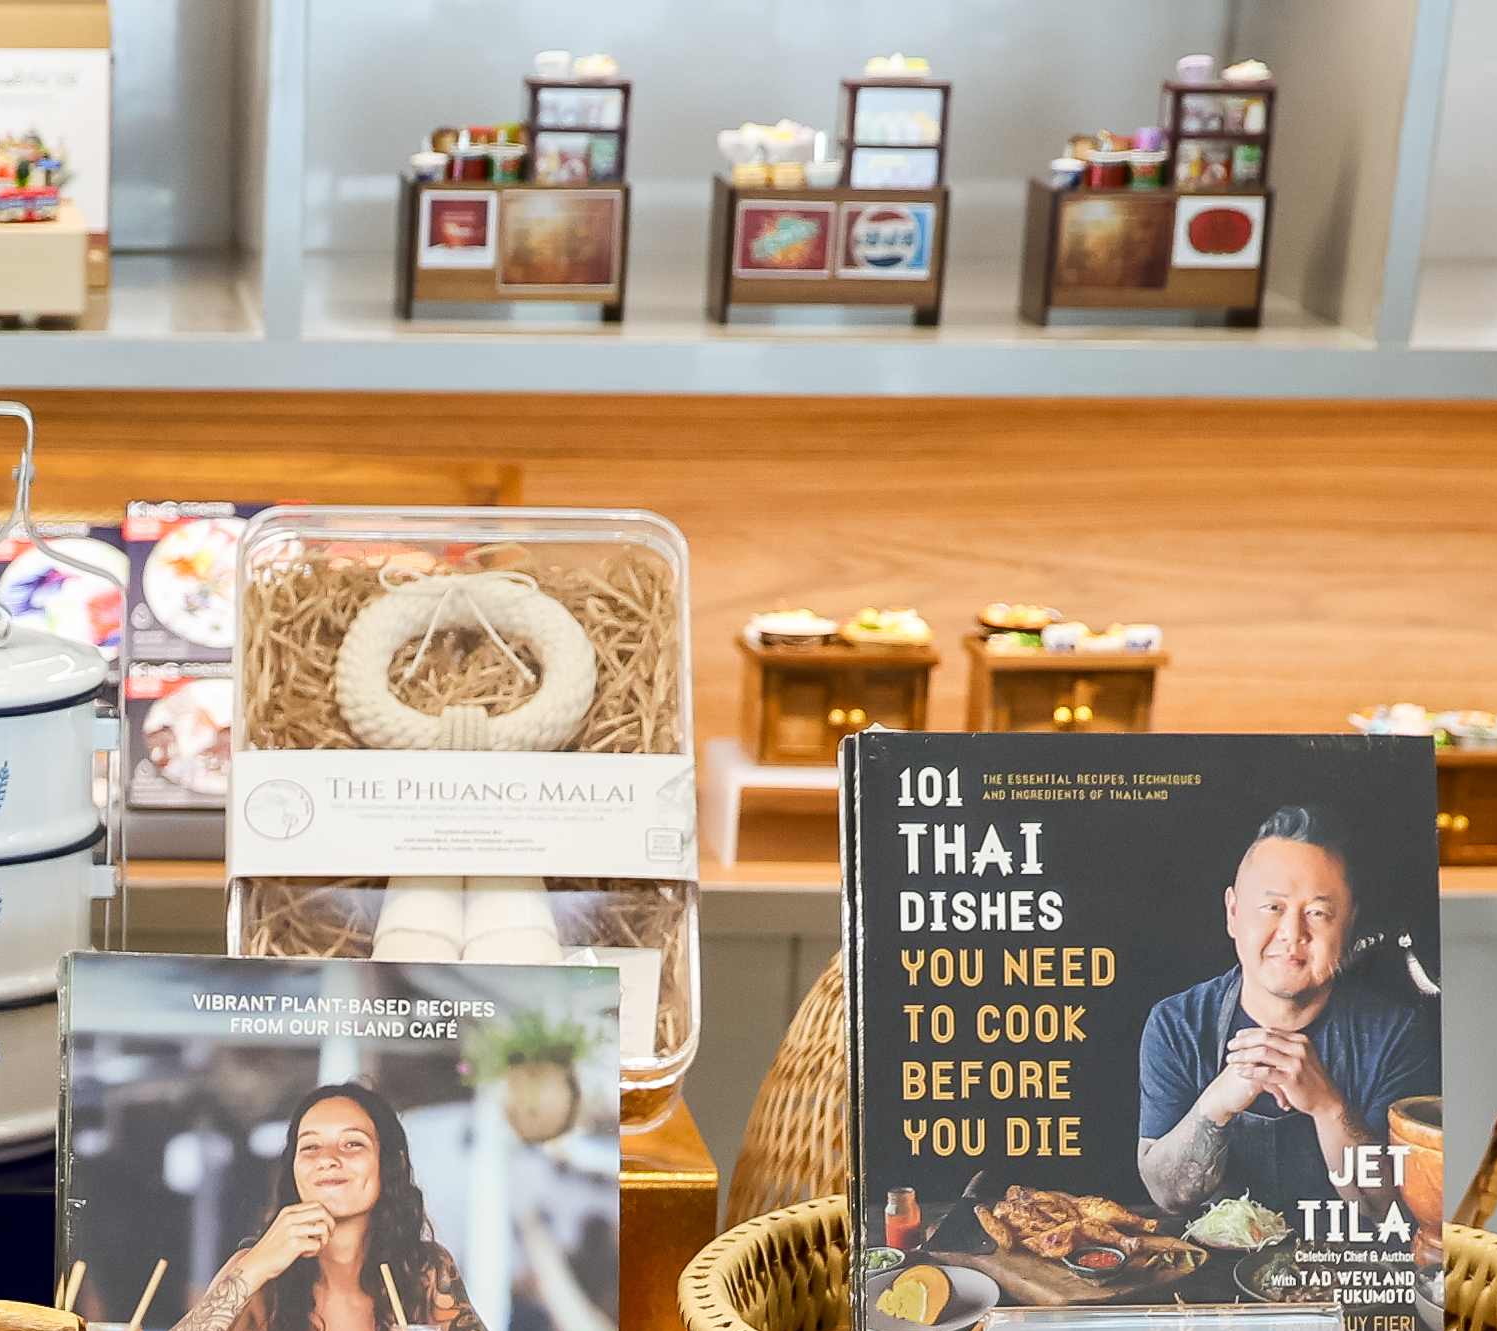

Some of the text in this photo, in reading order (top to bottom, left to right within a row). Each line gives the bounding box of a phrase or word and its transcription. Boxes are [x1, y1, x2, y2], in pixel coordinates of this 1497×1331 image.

[326, 777, 636, 804] THE PHUANG MALAI
[897, 766, 963, 808] 101
[981, 788, 1169, 802] AND INGREDIENTS OF THAILAND
[982, 772, 1203, 787] THE ESSENTIAL RECIPES, TECHNIQUES
[897, 822, 1044, 876] THAI
[899, 890, 1064, 933] DISHES
[901, 947, 1116, 987] YOU NEED
[192, 994, 496, 1018] VIBRANT PLANT-BASED RECIPES
[230, 1017, 458, 1039] FROM OUR ISLAND CAFÉ
[904, 1004, 1087, 1044] TO COOK
[902, 1060, 1072, 1101] BEFORE
[904, 1117, 1082, 1157] YOU DIE
[1328, 1145, 1411, 1188] JET
[1297, 1199, 1411, 1244] TILA
[1295, 1251, 1415, 1264] Celebrity Chef & Author
[1272, 1271, 1416, 1286] With TAD WEYLAND
[1333, 1289, 1416, 1303] FUKUMOTO
[1374, 1316, 1416, 1331] FIERI
